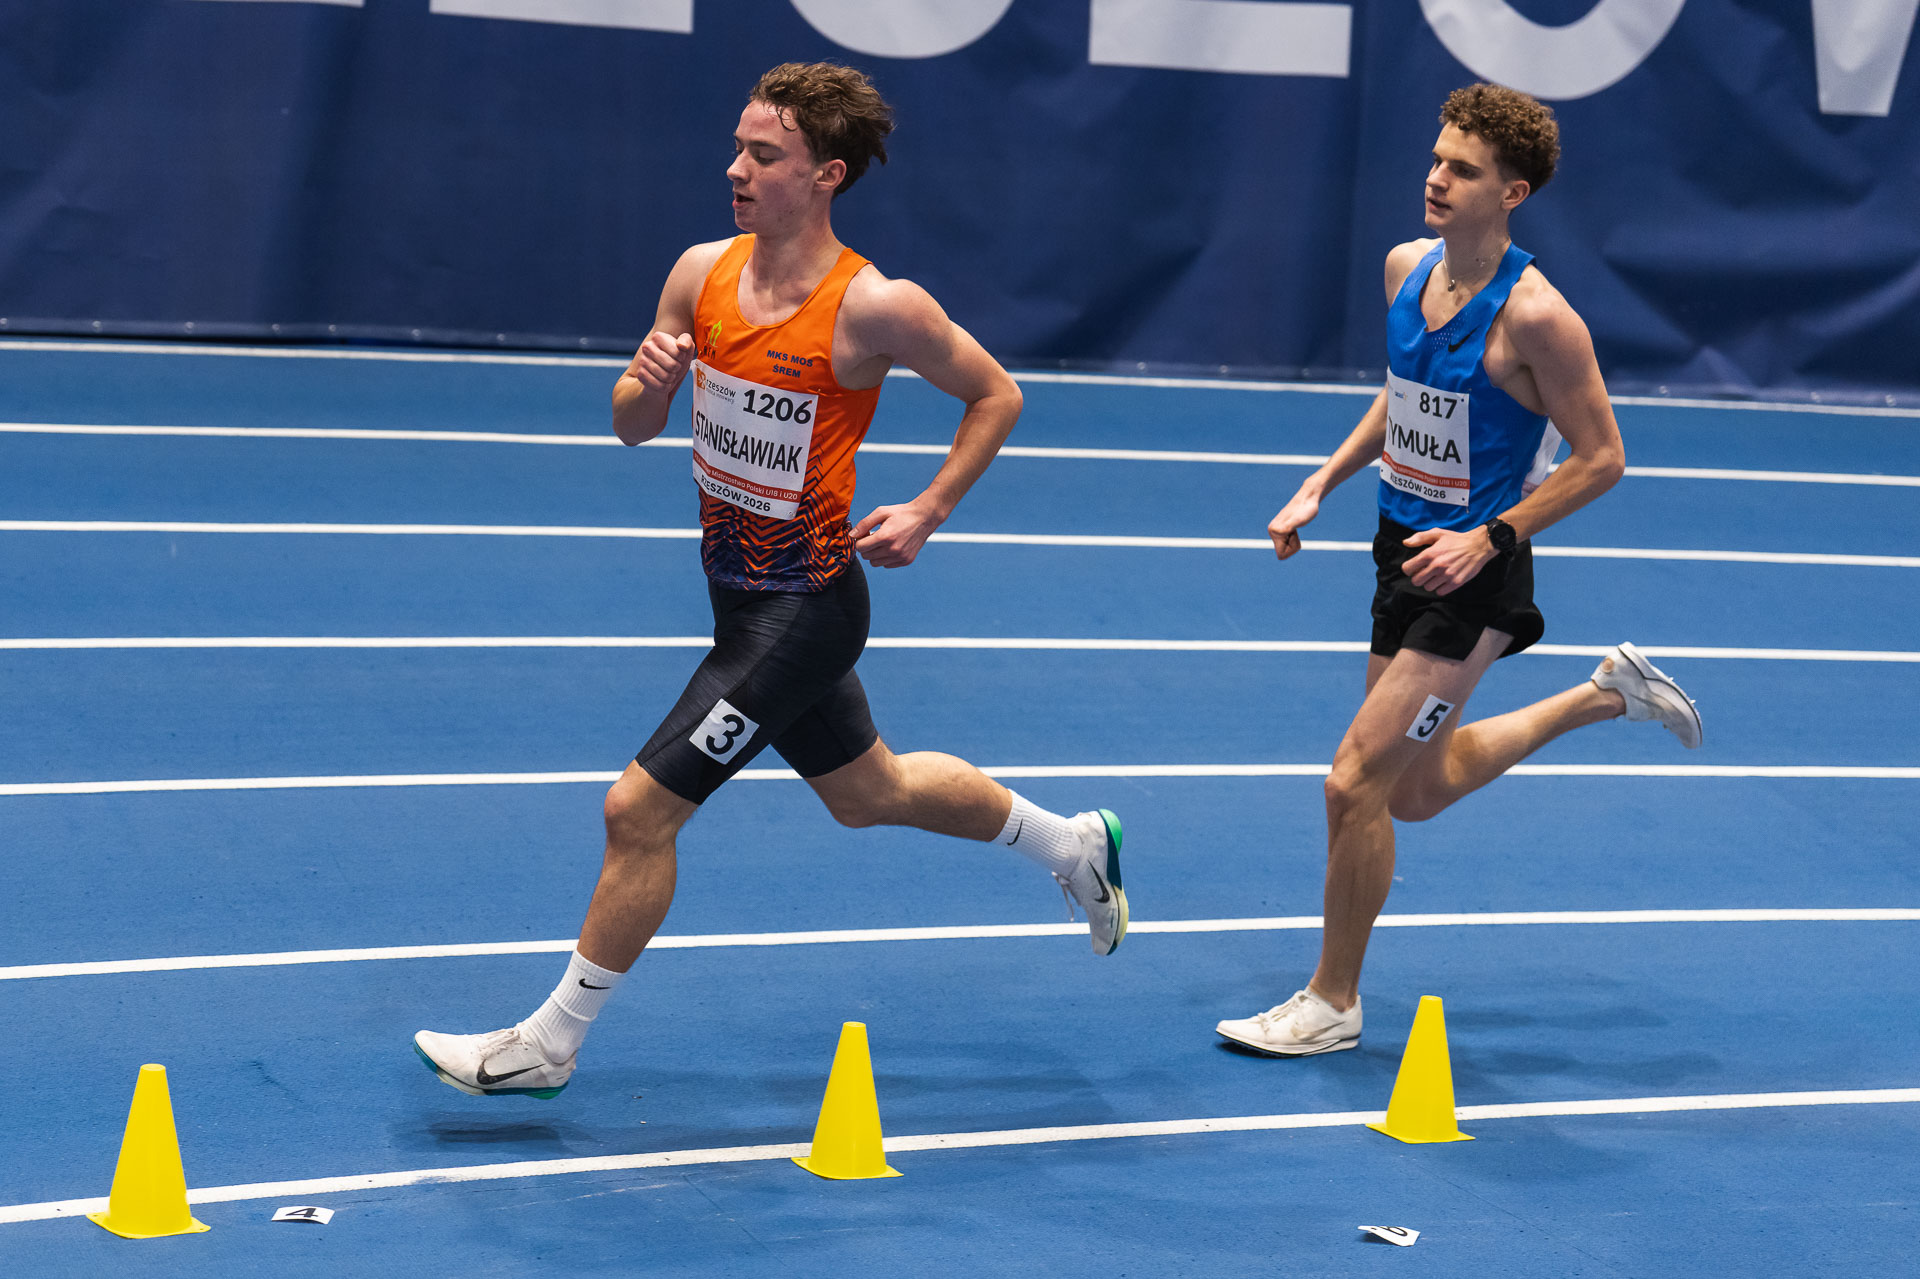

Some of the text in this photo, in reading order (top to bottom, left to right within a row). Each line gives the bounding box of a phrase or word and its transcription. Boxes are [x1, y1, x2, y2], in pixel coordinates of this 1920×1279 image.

[767, 350, 813, 367] MKS MOS
[772, 364, 802, 378] ŚREM
[743, 389, 812, 425] 1206
[1419, 391, 1458, 419] 817
[695, 410, 803, 474] STANISŁAWIAK
[1388, 415, 1462, 464] YMUŁA
[746, 483, 765, 495] Polski
[765, 489, 778, 497] U18
[783, 491, 798, 500] U20
[1423, 486, 1447, 499] 2026
[743, 495, 771, 512] 2026
[1417, 702, 1449, 738] 5
[706, 713, 746, 755] 3
[285, 1207, 319, 1218] 4
